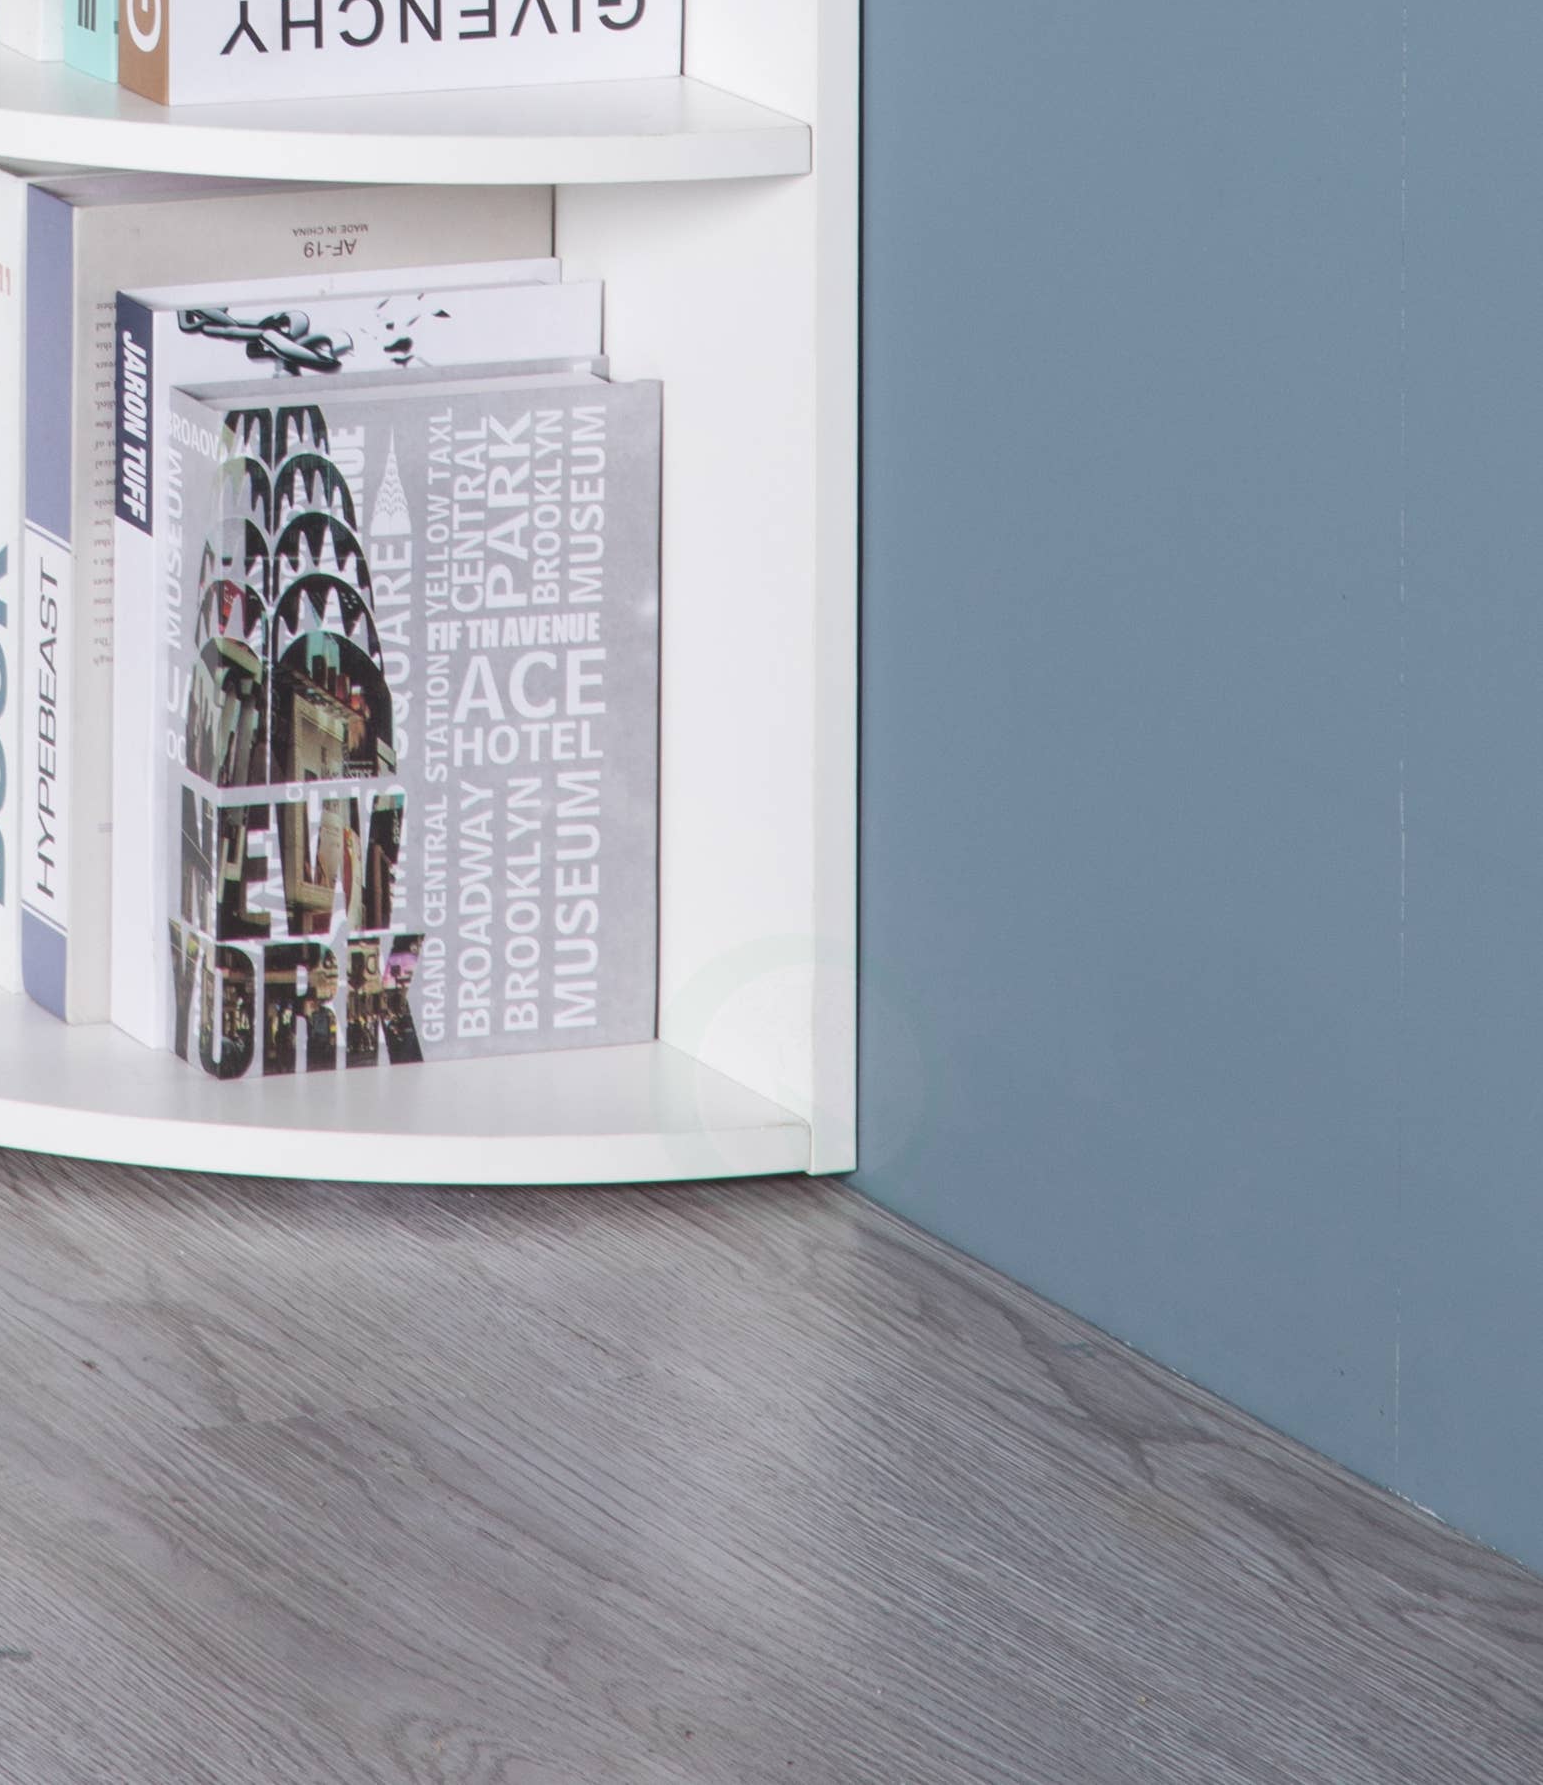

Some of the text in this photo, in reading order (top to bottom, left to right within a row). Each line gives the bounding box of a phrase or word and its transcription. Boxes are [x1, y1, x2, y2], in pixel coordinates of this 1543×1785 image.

[292, 223, 369, 237] MADE IN CHINA
[303, 238, 357, 259] AF-19
[122, 330, 147, 523] JARON TUFF
[450, 416, 488, 613] CENTRAL
[485, 410, 532, 609] PARK
[532, 408, 564, 605] BROOKLYN
[568, 404, 607, 604] MUSEUM
[424, 493, 451, 617] YELLOW
[502, 612, 601, 648] AVENUE
[37, 556, 59, 899] HYPEBEAST
[452, 646, 607, 725] ACE
[453, 720, 604, 768] HOTEL
[179, 784, 408, 941] NEW
[422, 654, 450, 1044] GRAND CENTRAL STATION
[456, 780, 494, 1038] BROADWAY
[503, 776, 543, 1032] BROOKLYN
[553, 770, 601, 1029] MUSEUM
[168, 933, 426, 1081] YORK
